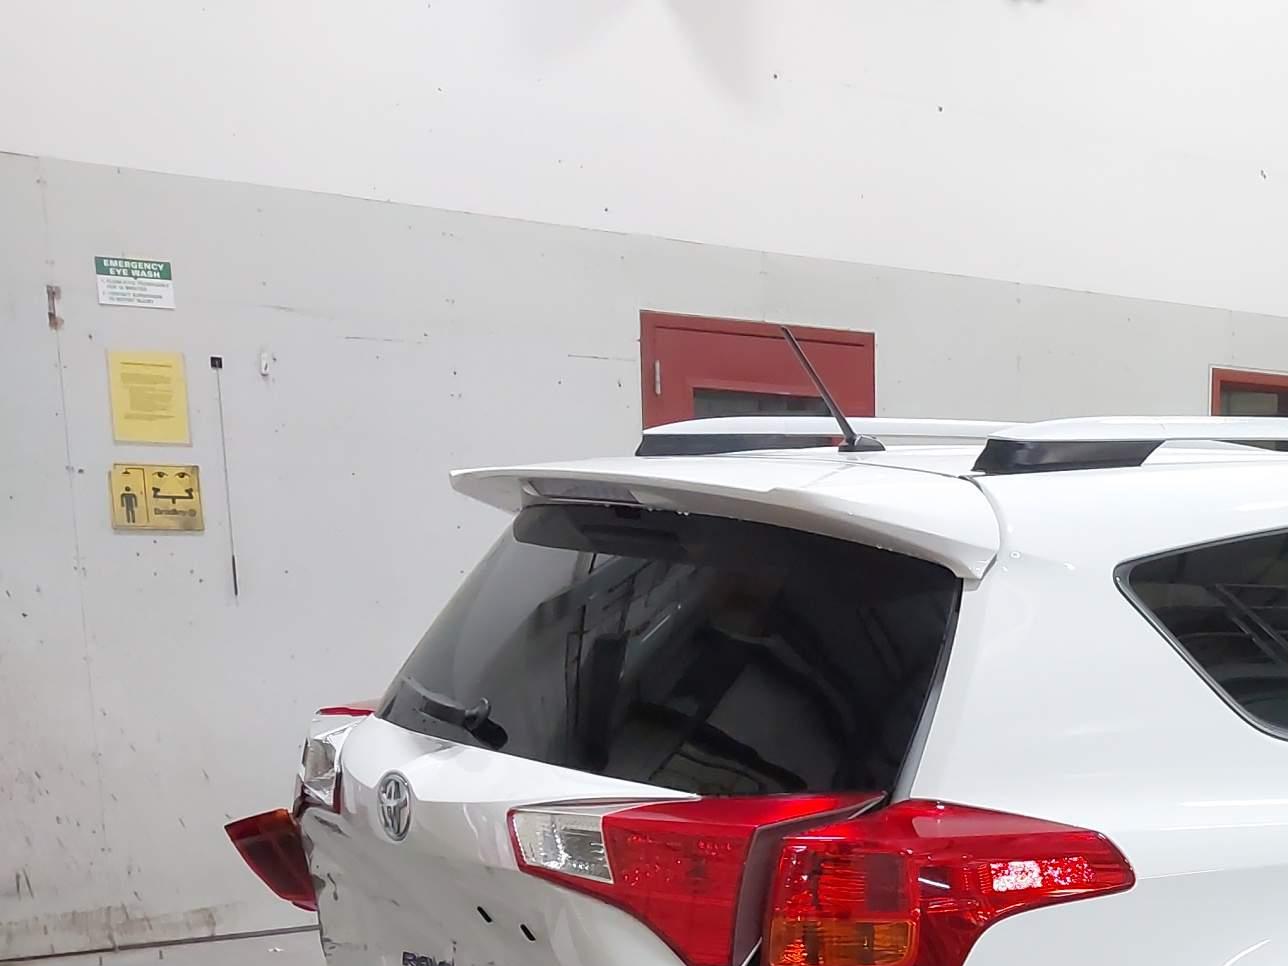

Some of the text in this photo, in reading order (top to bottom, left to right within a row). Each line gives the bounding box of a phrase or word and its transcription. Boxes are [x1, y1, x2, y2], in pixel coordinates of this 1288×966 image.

[103, 259, 164, 271] EMERGENCY
[109, 267, 161, 279] EYE WASH
